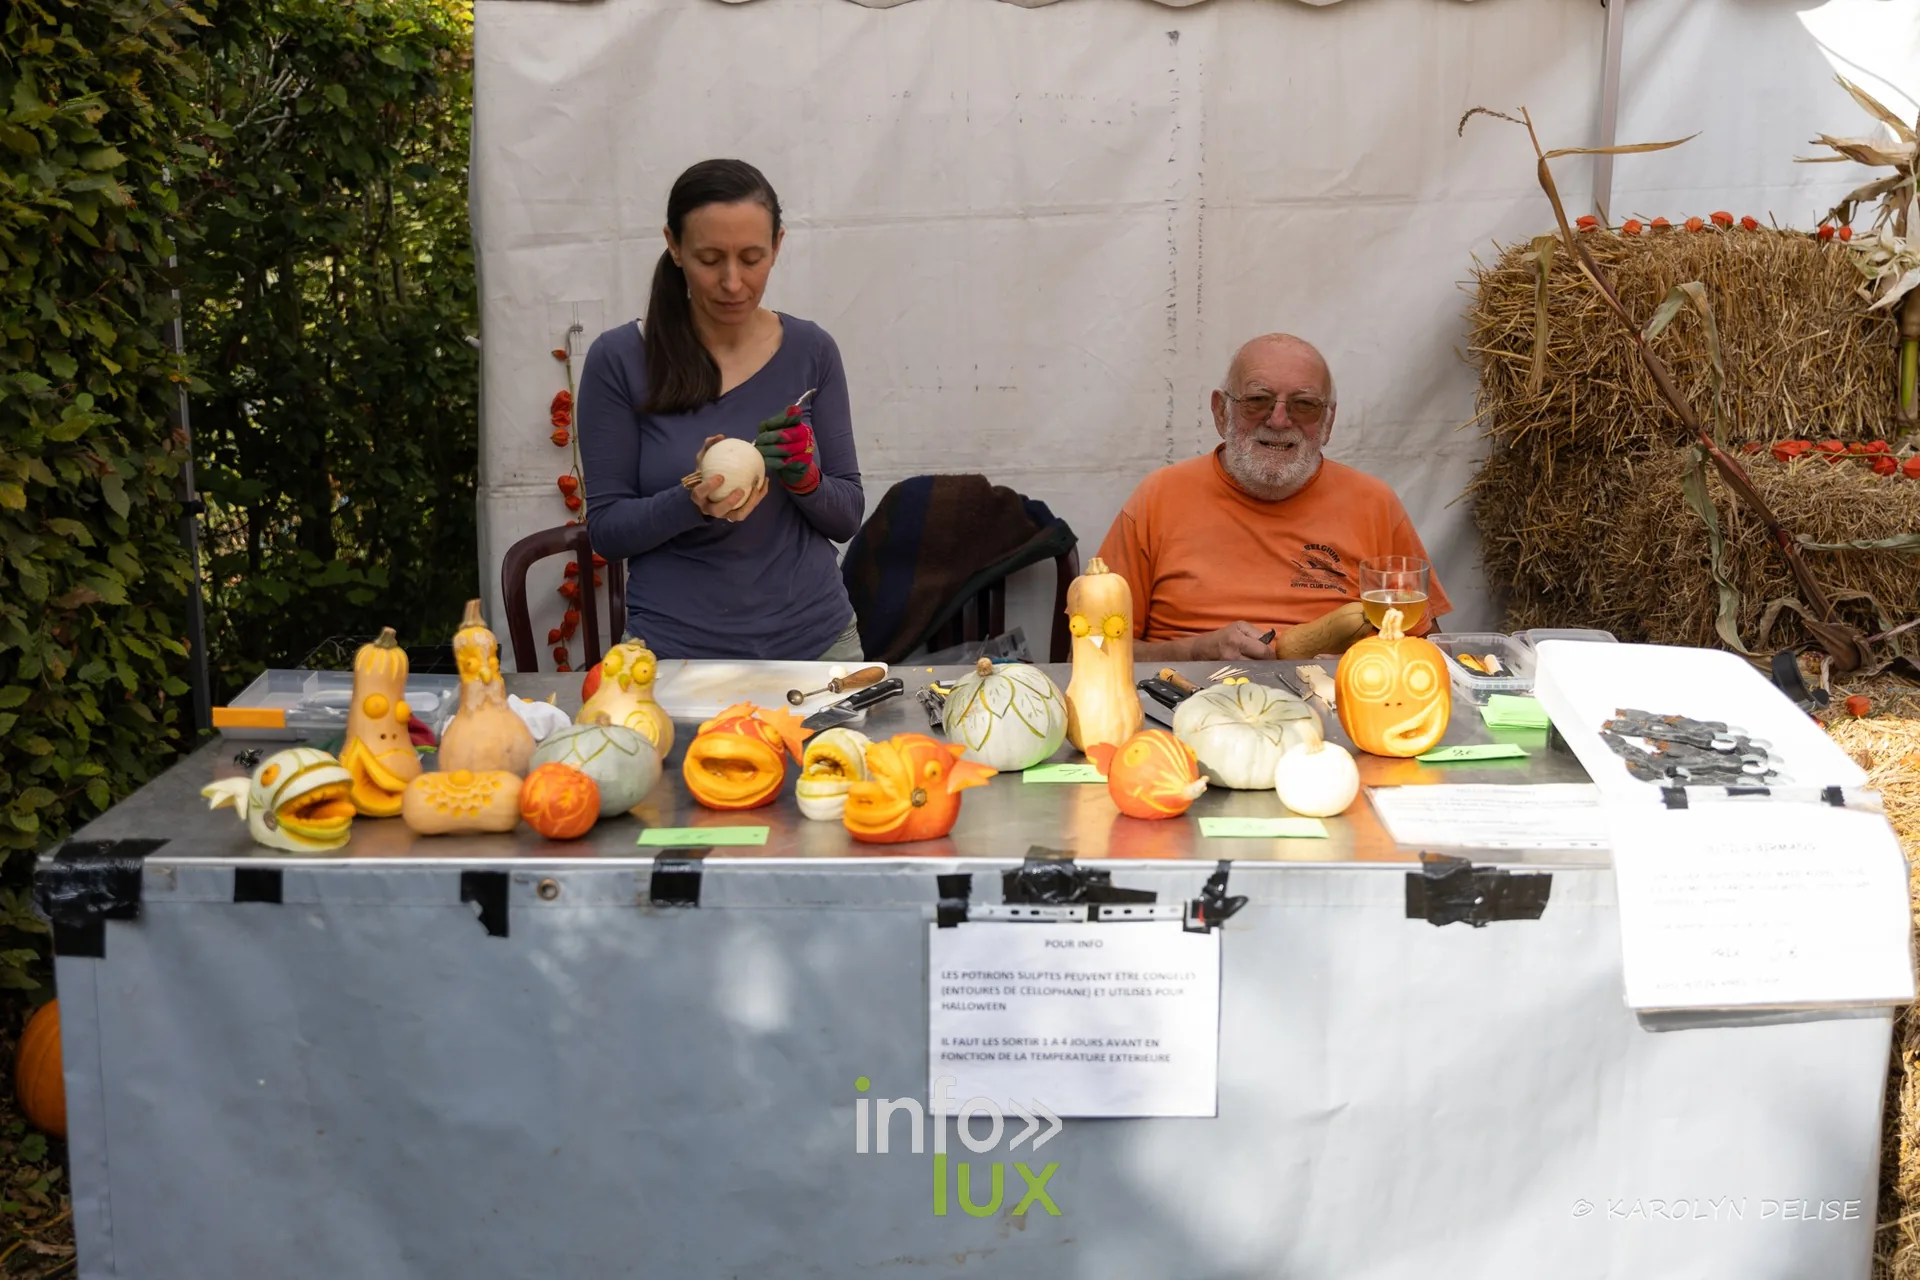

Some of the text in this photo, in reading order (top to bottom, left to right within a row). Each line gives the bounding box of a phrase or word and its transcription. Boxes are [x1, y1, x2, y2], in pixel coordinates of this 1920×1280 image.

[1304, 544, 1340, 563] BELGIUM
[1044, 939, 1104, 949] POUR INFO
[941, 971, 959, 980] LES
[961, 971, 1015, 980] POTIRONS
[1017, 971, 1062, 981] SULPTES
[1064, 972, 1113, 981] PEUVENT
[1115, 972, 1140, 981] ETRE
[941, 986, 1001, 997] (ENTOURES
[1003, 986, 1017, 996] DE
[1020, 986, 1092, 998] CELLOPHANE)
[1094, 987, 1106, 997] ET
[1109, 987, 1152, 997] UTILISES
[941, 1001, 1007, 1011] HALLOWEEN
[941, 1037, 950, 1046] IL
[952, 1037, 979, 1046] FAUT
[982, 1037, 1000, 1046] LES
[1002, 1037, 1040, 1046] SORTIR
[1051, 1037, 1060, 1047] A
[1070, 1037, 1103, 1047] JOURS
[1106, 1038, 1142, 1048] AVANT
[1145, 1038, 1160, 1048] EN
[941, 1052, 1171, 1063] FONCTION DE LA TEMPERATURE EXTERIEURE
